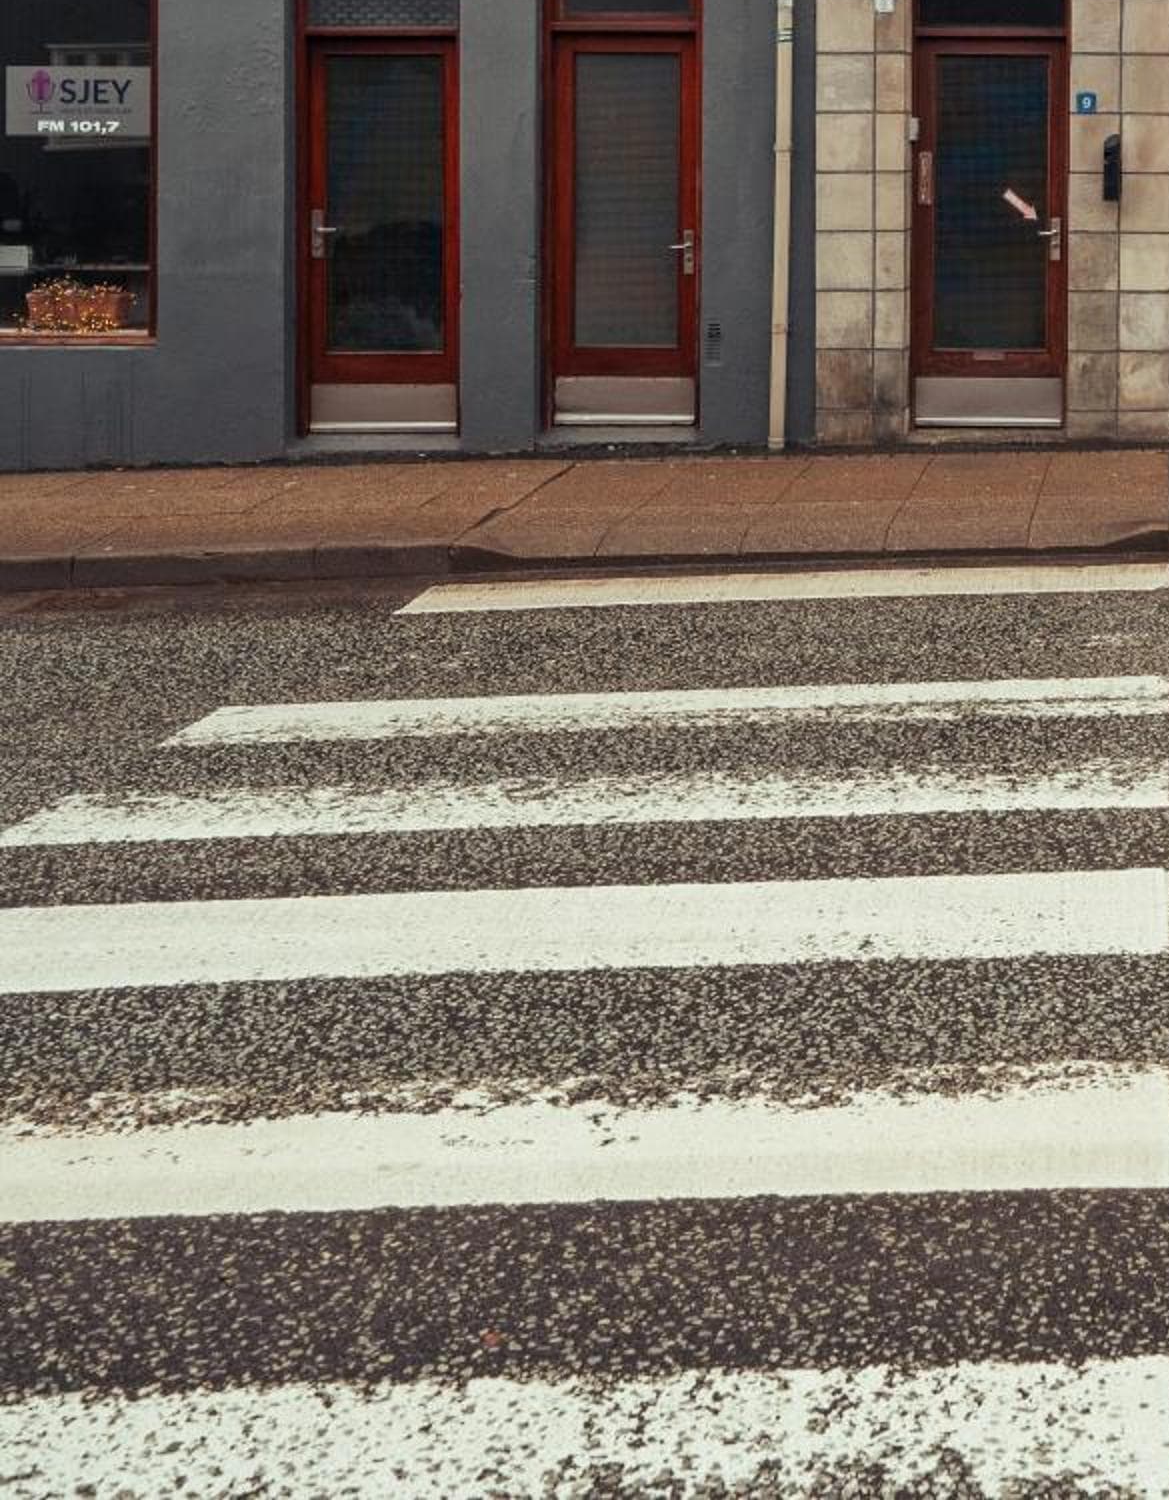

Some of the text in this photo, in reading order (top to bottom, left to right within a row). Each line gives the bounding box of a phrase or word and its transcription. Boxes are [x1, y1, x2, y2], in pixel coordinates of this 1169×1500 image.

[60, 79, 132, 104] SJEY
[1082, 96, 1092, 109] 9
[37, 120, 120, 135] FM 101,7
